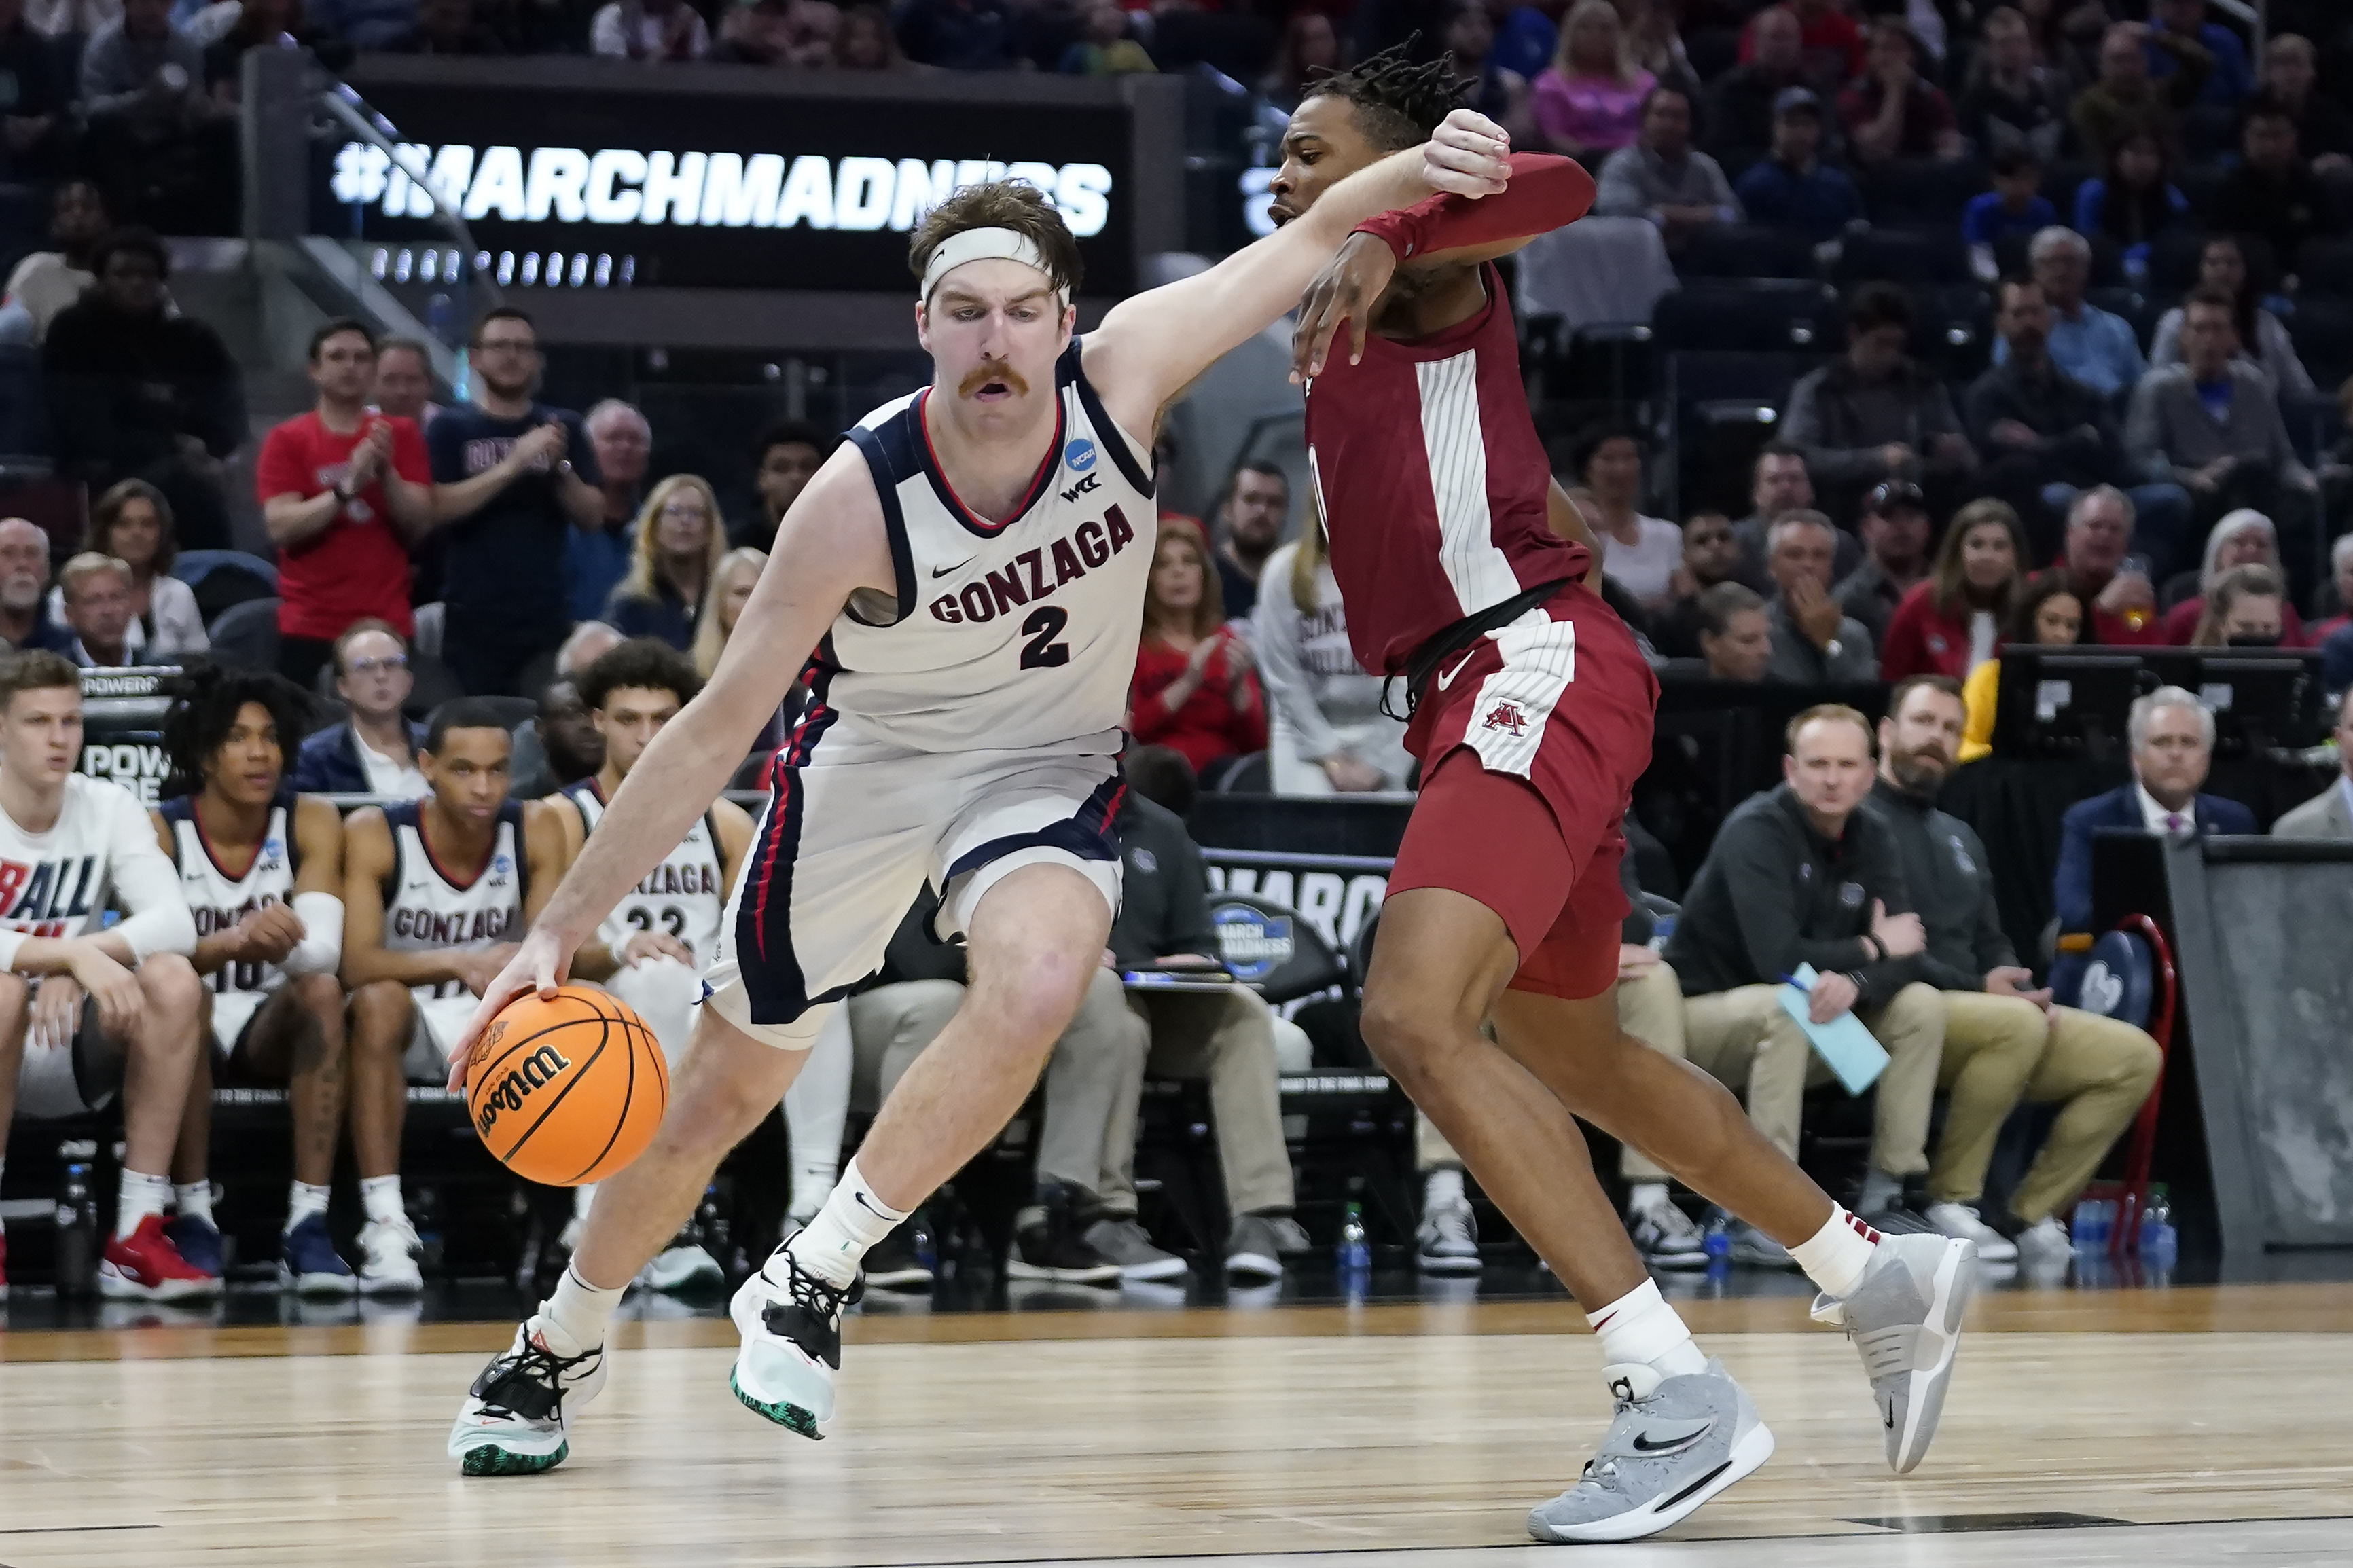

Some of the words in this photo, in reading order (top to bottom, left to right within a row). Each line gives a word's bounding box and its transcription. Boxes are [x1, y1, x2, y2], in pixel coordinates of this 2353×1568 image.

[1071, 448, 1095, 467] NCAA
[929, 503, 1134, 623] GONZAGA
[1020, 606, 1071, 670] 2
[629, 861, 715, 895] ZAGA
[478, 1044, 573, 1138] Wilson
